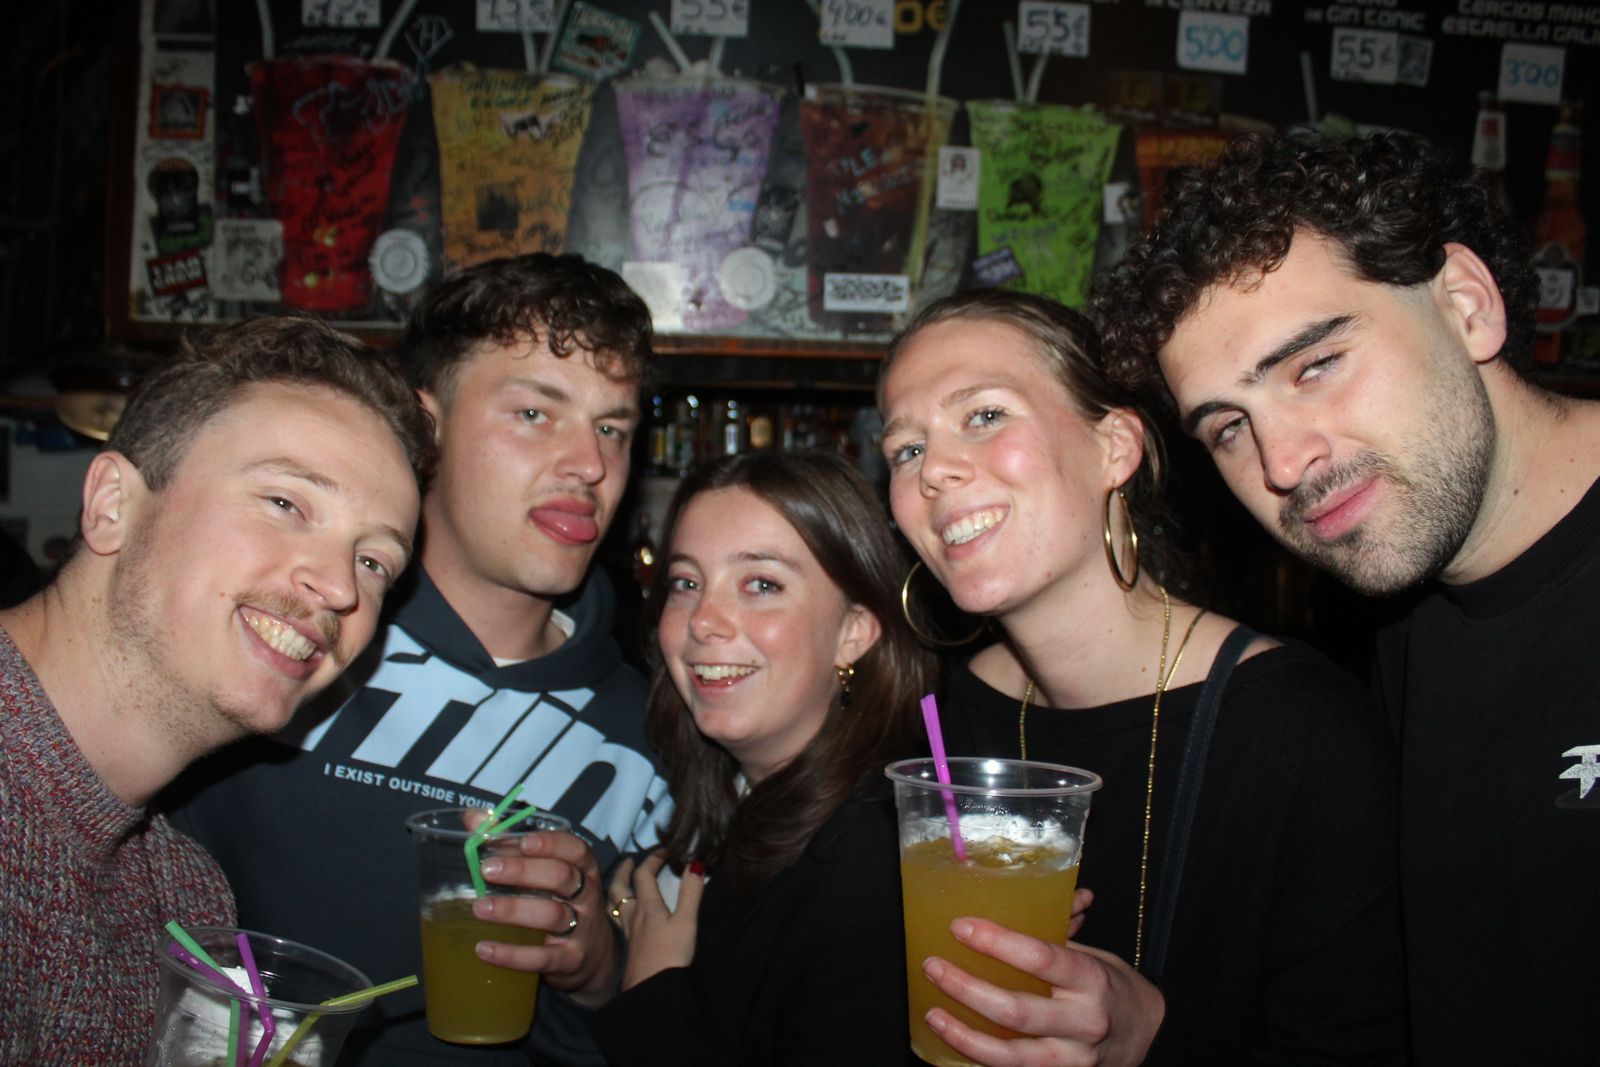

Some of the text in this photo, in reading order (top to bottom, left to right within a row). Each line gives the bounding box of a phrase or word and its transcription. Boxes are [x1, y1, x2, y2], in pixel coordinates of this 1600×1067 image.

[1548, 4, 1600, 27] MAHO
[1552, 23, 1600, 46] GALI
[324, 762, 331, 776] I
[335, 765, 385, 786] EXIST
[389, 777, 455, 803] OUTSIDE
